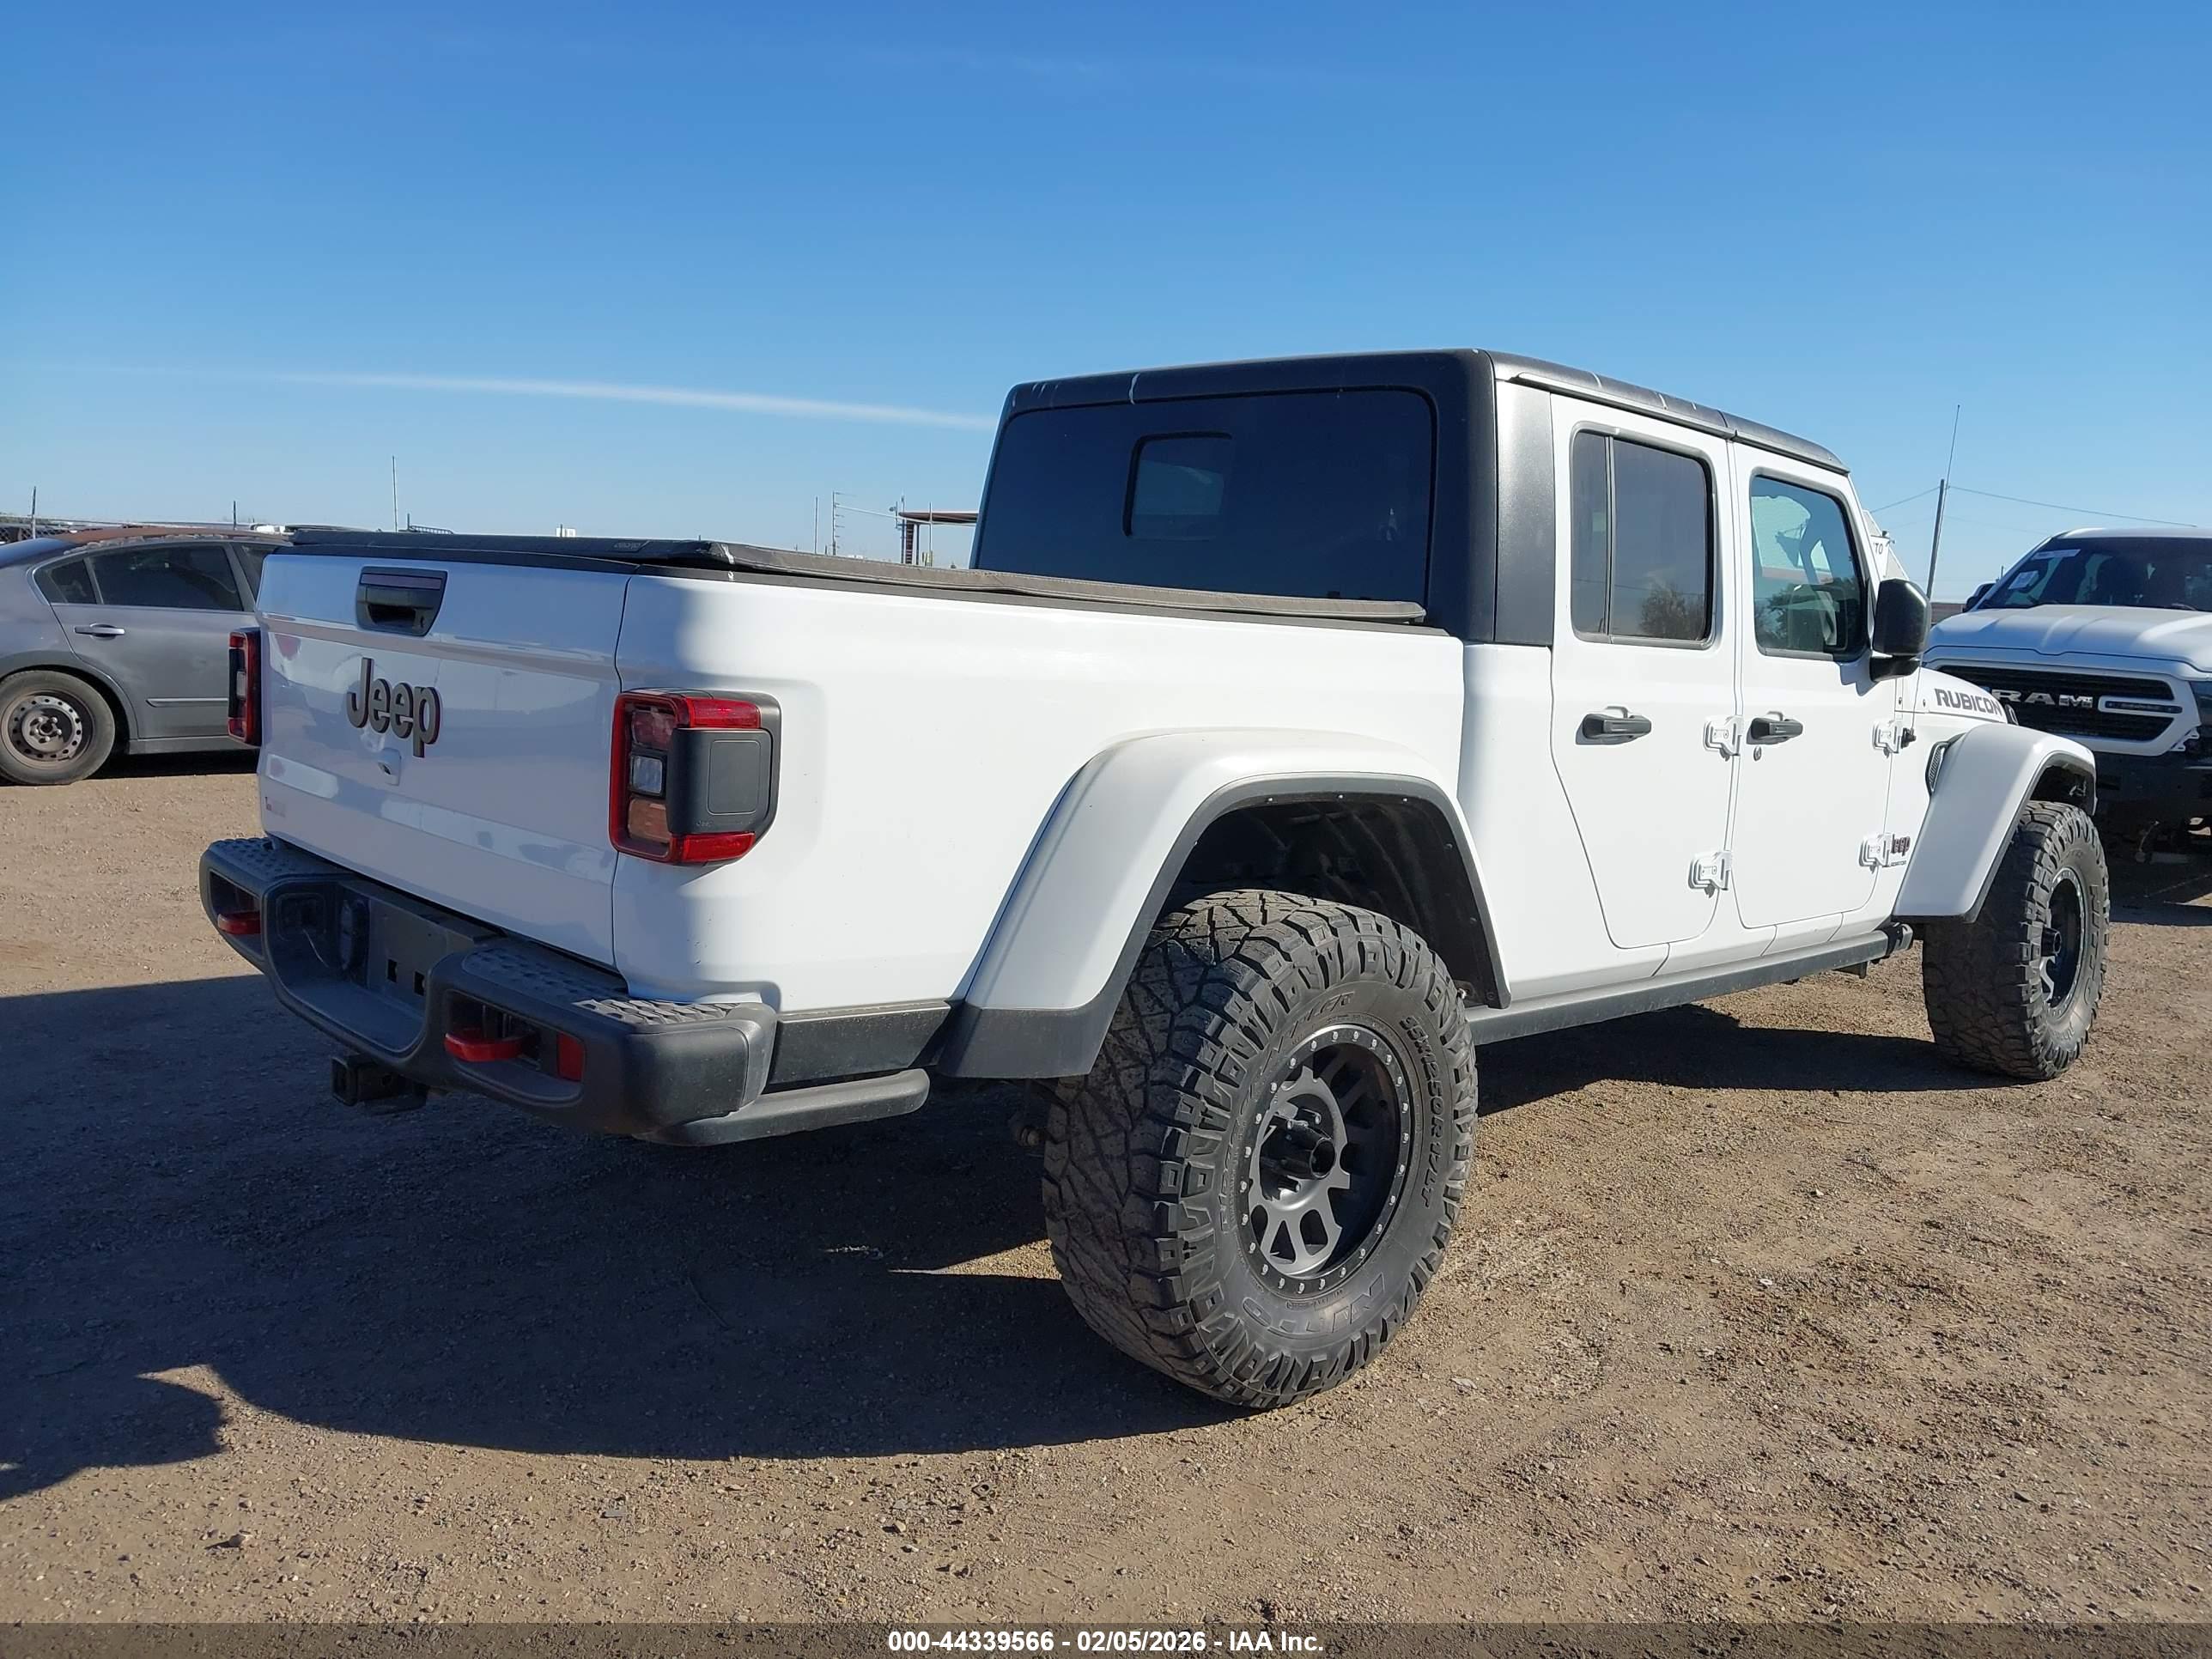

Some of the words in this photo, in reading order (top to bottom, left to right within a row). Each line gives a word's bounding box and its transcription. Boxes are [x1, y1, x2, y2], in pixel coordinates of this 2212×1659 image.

[347, 658, 441, 757] Jeep
[1934, 688, 2003, 716] RUBICON
[1991, 689, 2093, 708] RAM
[1891, 834, 1911, 857] Jeep
